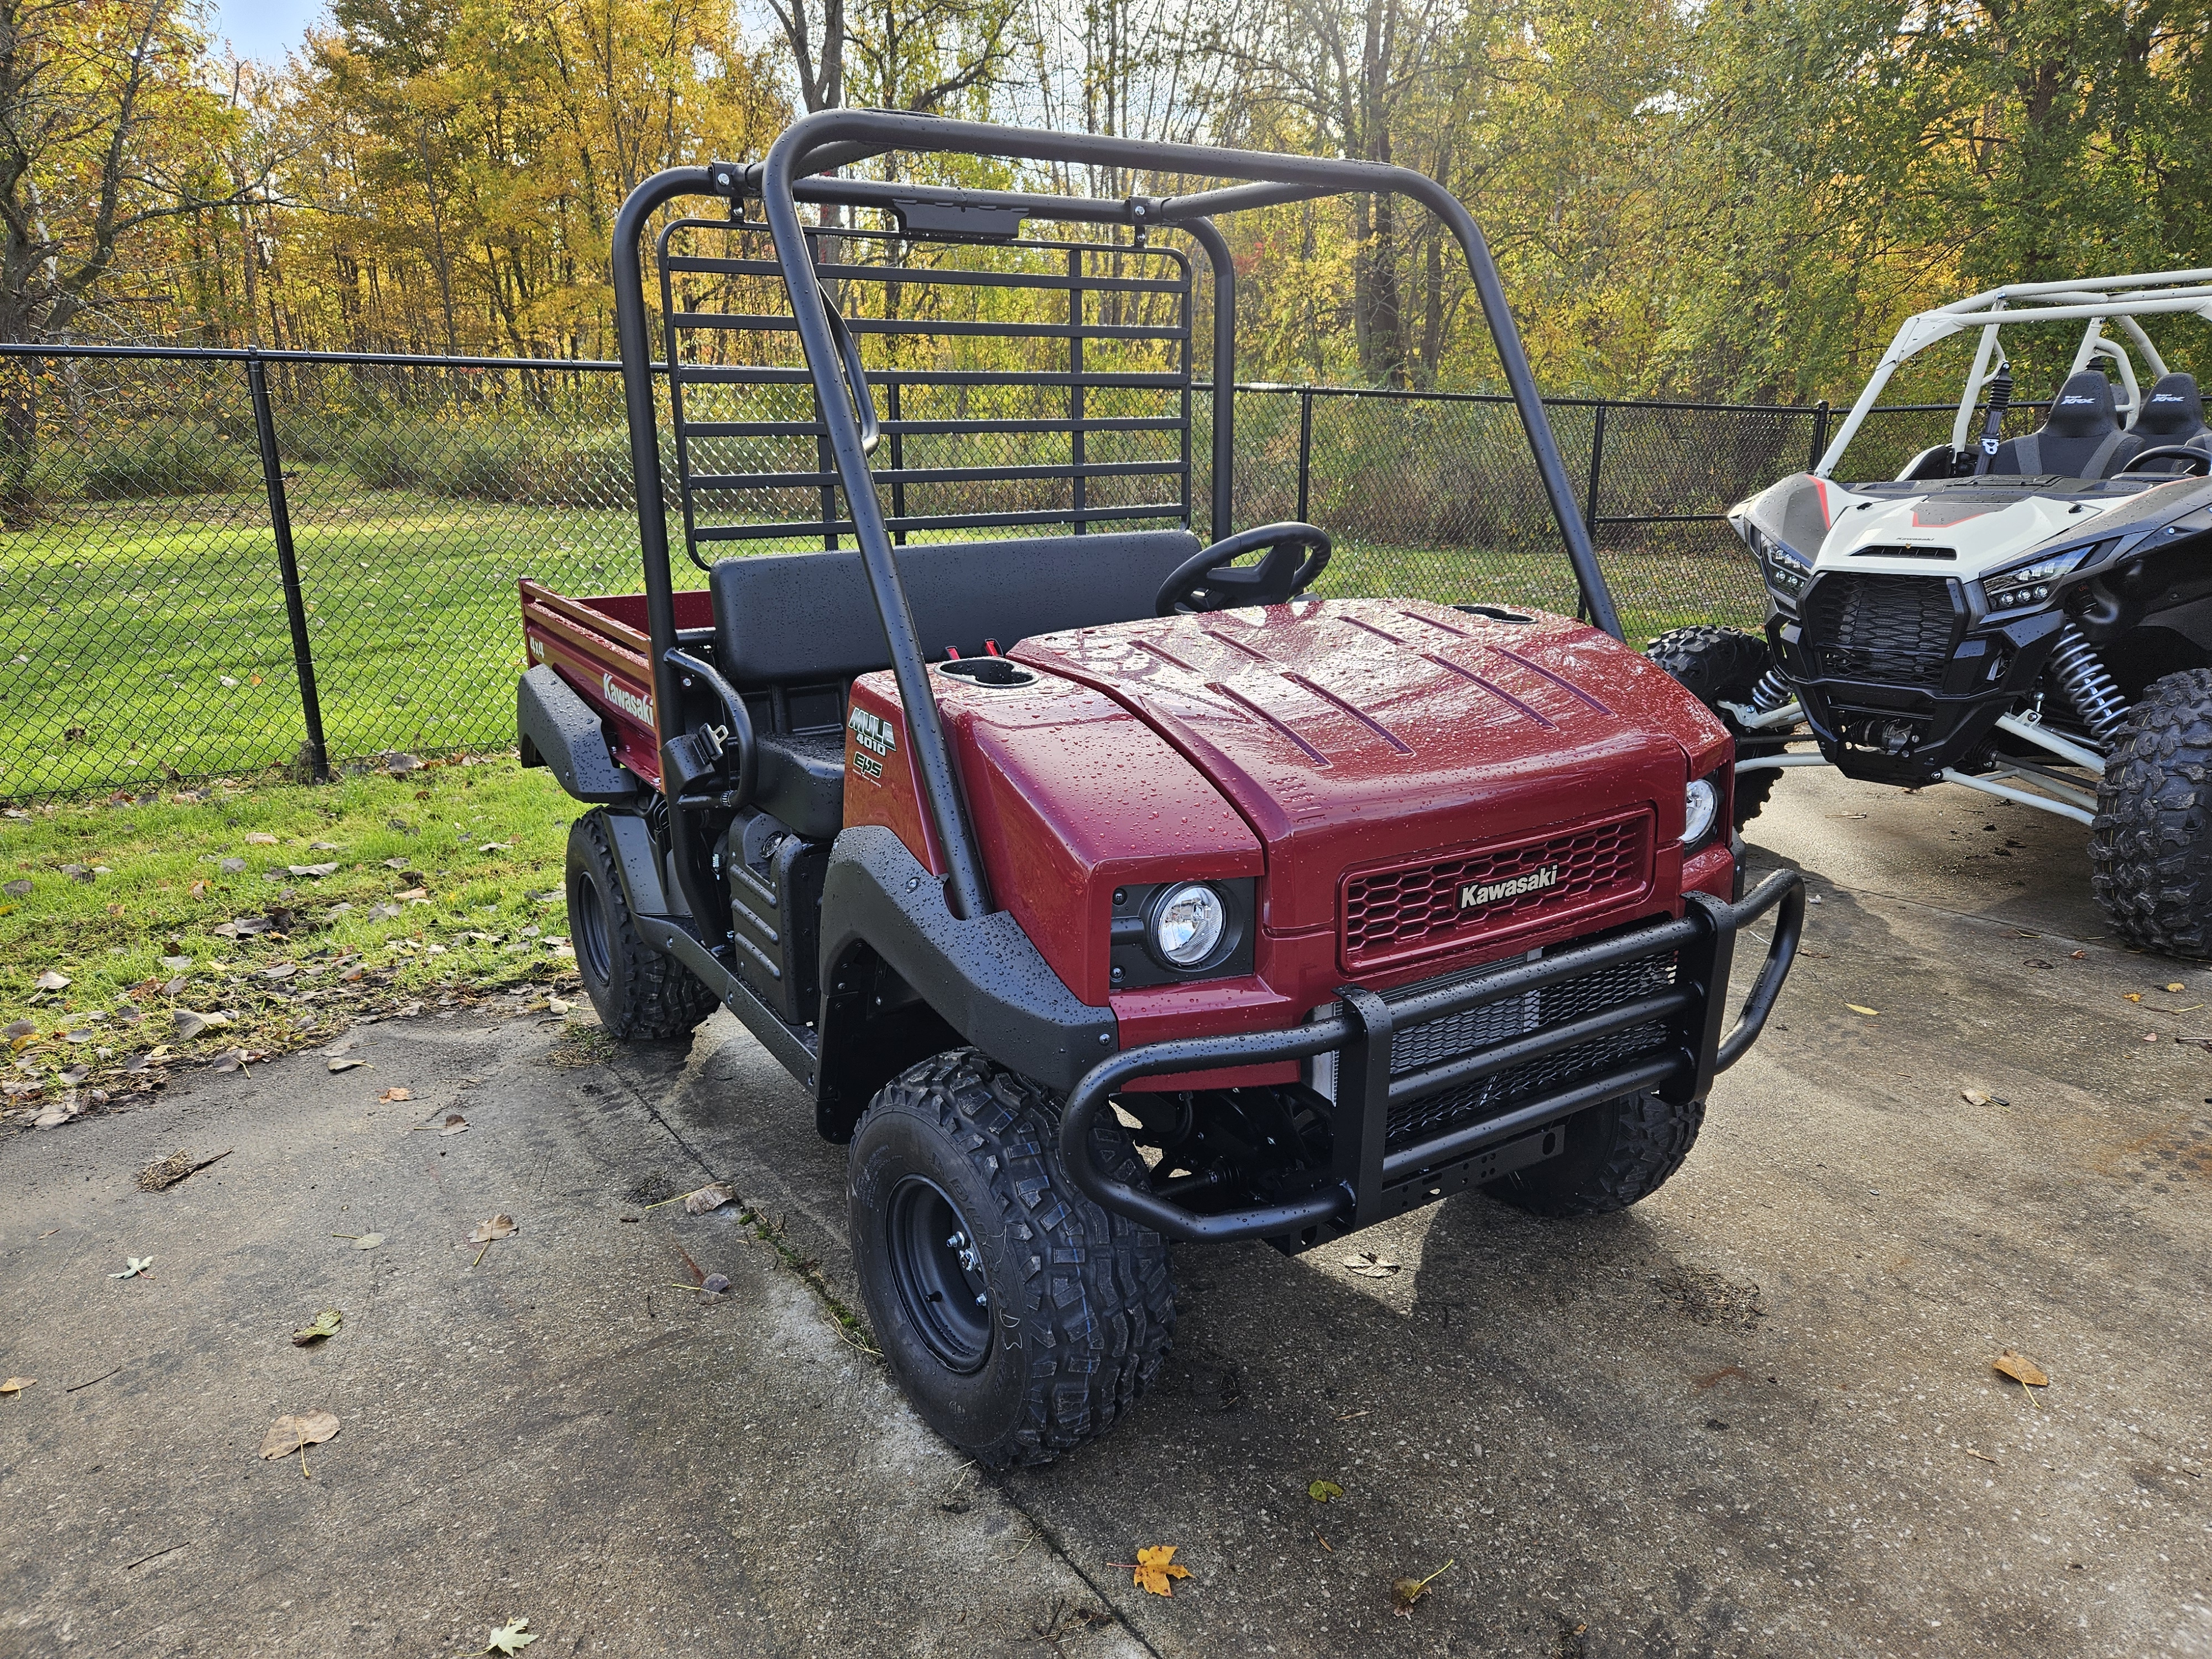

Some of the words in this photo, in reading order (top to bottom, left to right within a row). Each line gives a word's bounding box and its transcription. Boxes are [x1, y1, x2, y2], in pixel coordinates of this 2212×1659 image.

[530, 636, 545, 658] 4x4
[603, 672, 654, 727] Kawasaki
[848, 707, 896, 752] MULE
[855, 733, 886, 757] 4010
[853, 751, 883, 778] EPS
[1461, 864, 1558, 909] Kawasaki
